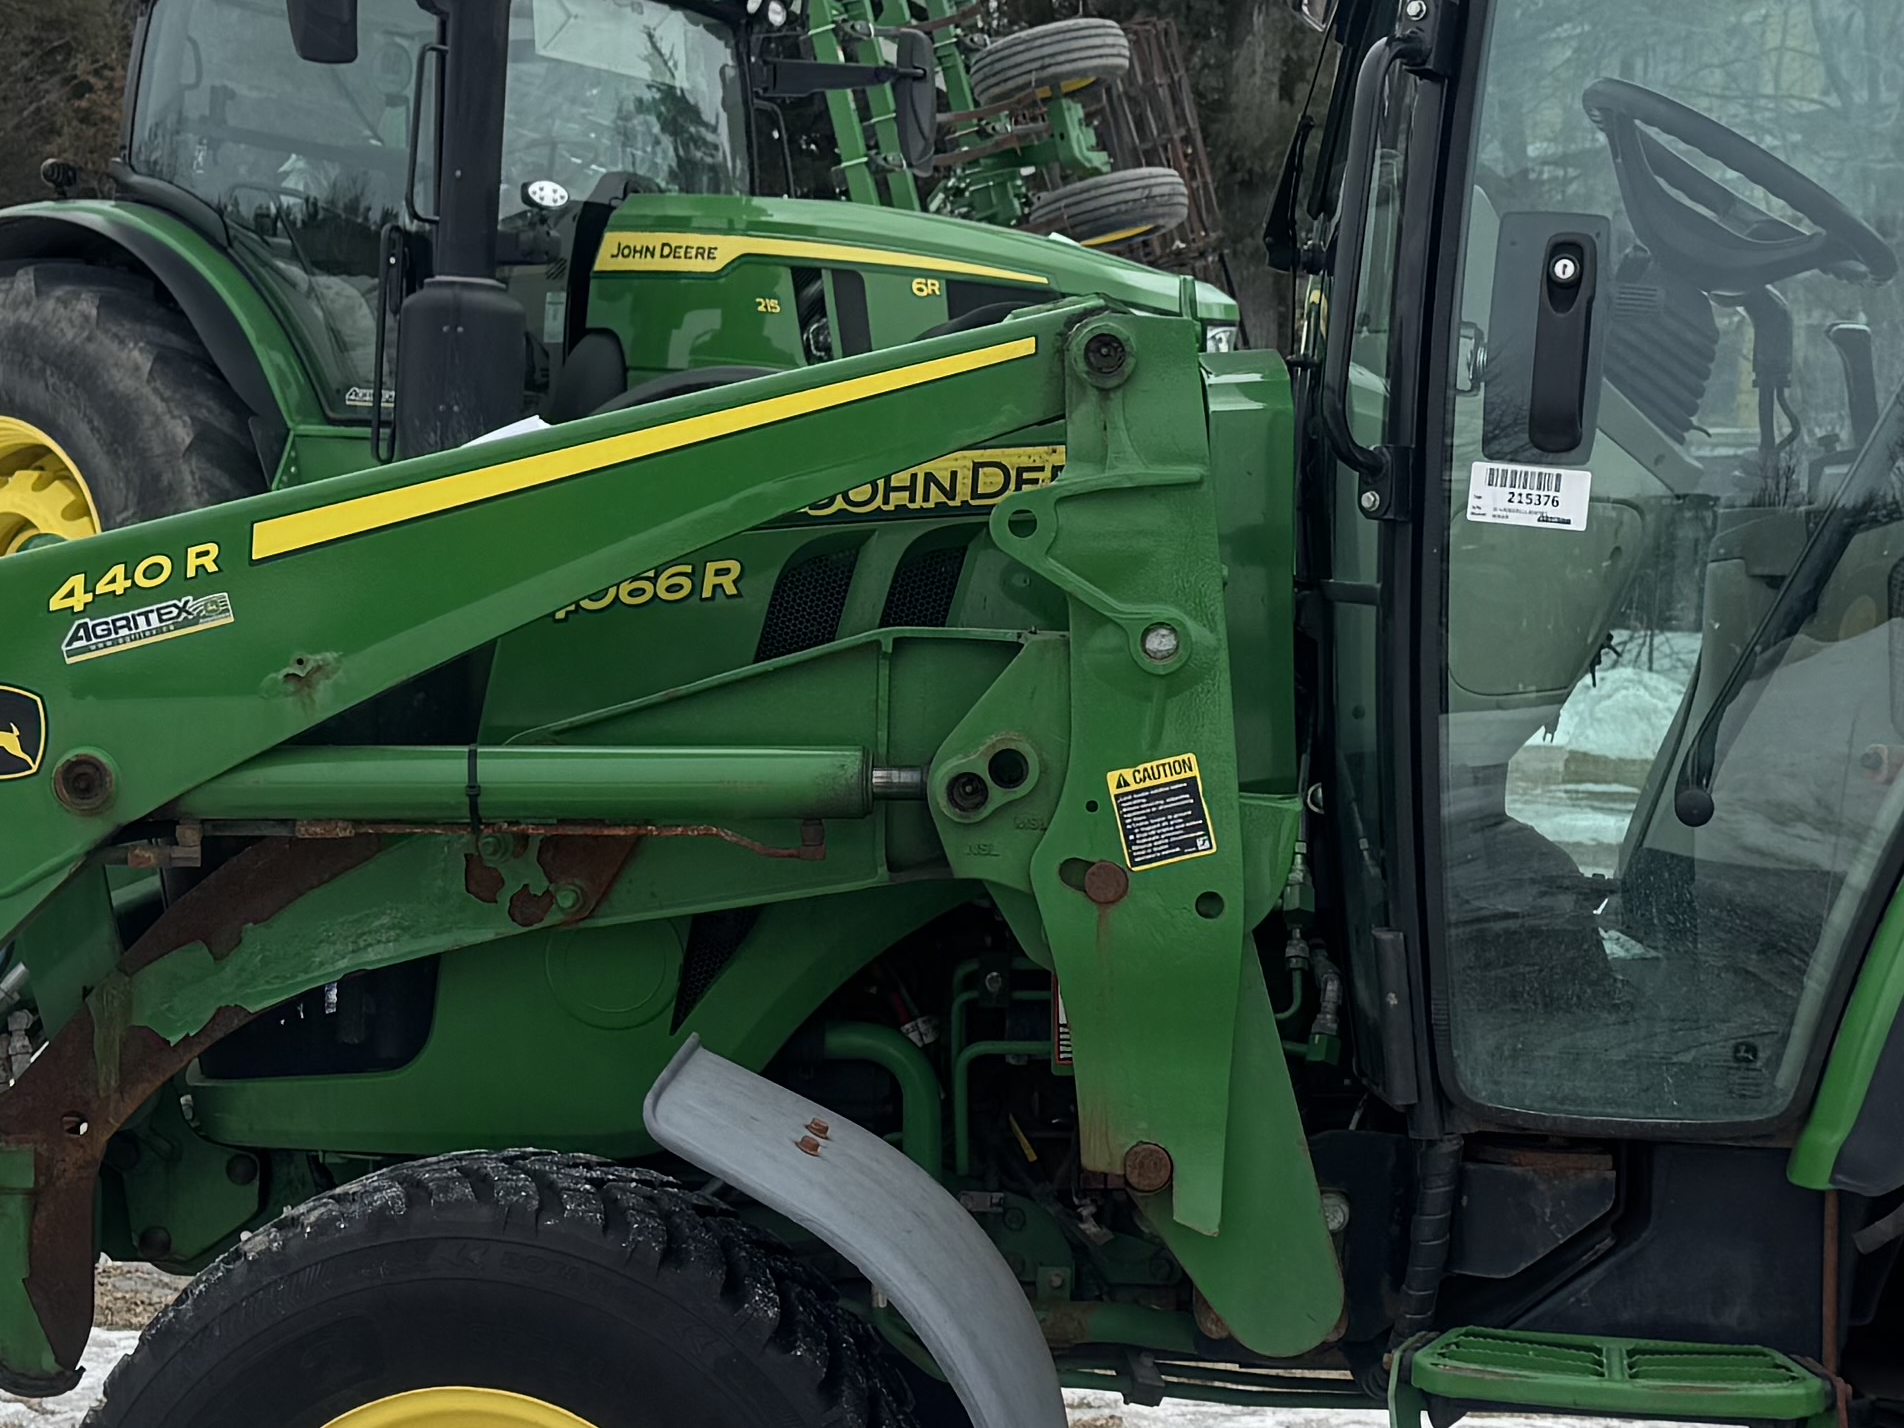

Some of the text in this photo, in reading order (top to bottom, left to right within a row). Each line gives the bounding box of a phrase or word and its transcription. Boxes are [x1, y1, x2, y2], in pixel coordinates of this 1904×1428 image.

[611, 241, 718, 261] JOHN DEERE
[911, 277, 941, 297] 6R
[755, 297, 781, 313] 215
[1507, 492, 1560, 507] 215376
[49, 542, 219, 613] 440 R
[700, 558, 742, 598] R
[65, 598, 194, 648] AGRITEX
[1132, 756, 1194, 785] CAUTION
